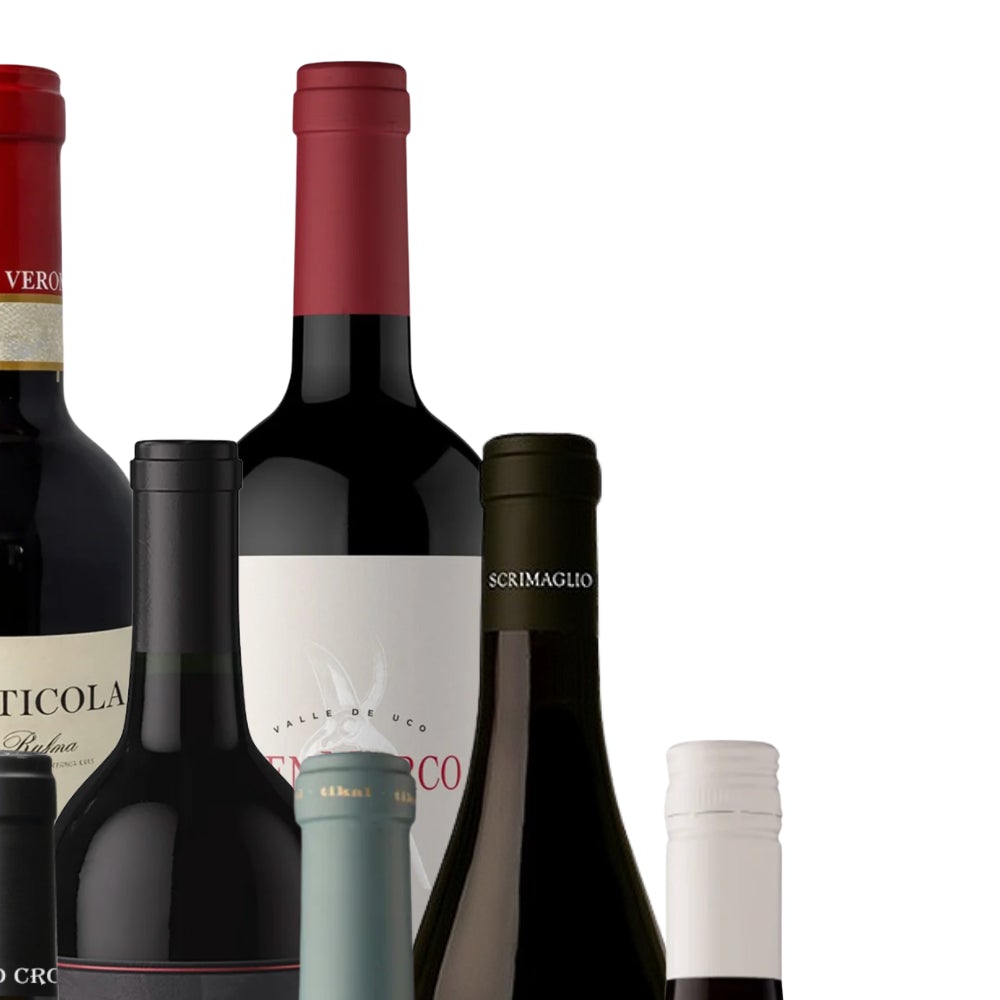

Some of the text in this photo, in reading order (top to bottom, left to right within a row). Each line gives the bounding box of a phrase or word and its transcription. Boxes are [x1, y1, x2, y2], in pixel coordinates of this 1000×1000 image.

[5, 271, 62, 291] VERO
[488, 571, 593, 588] SCRIMAGLIO
[273, 708, 427, 734] VALLE DE UCO
[320, 785, 371, 798] tikal
